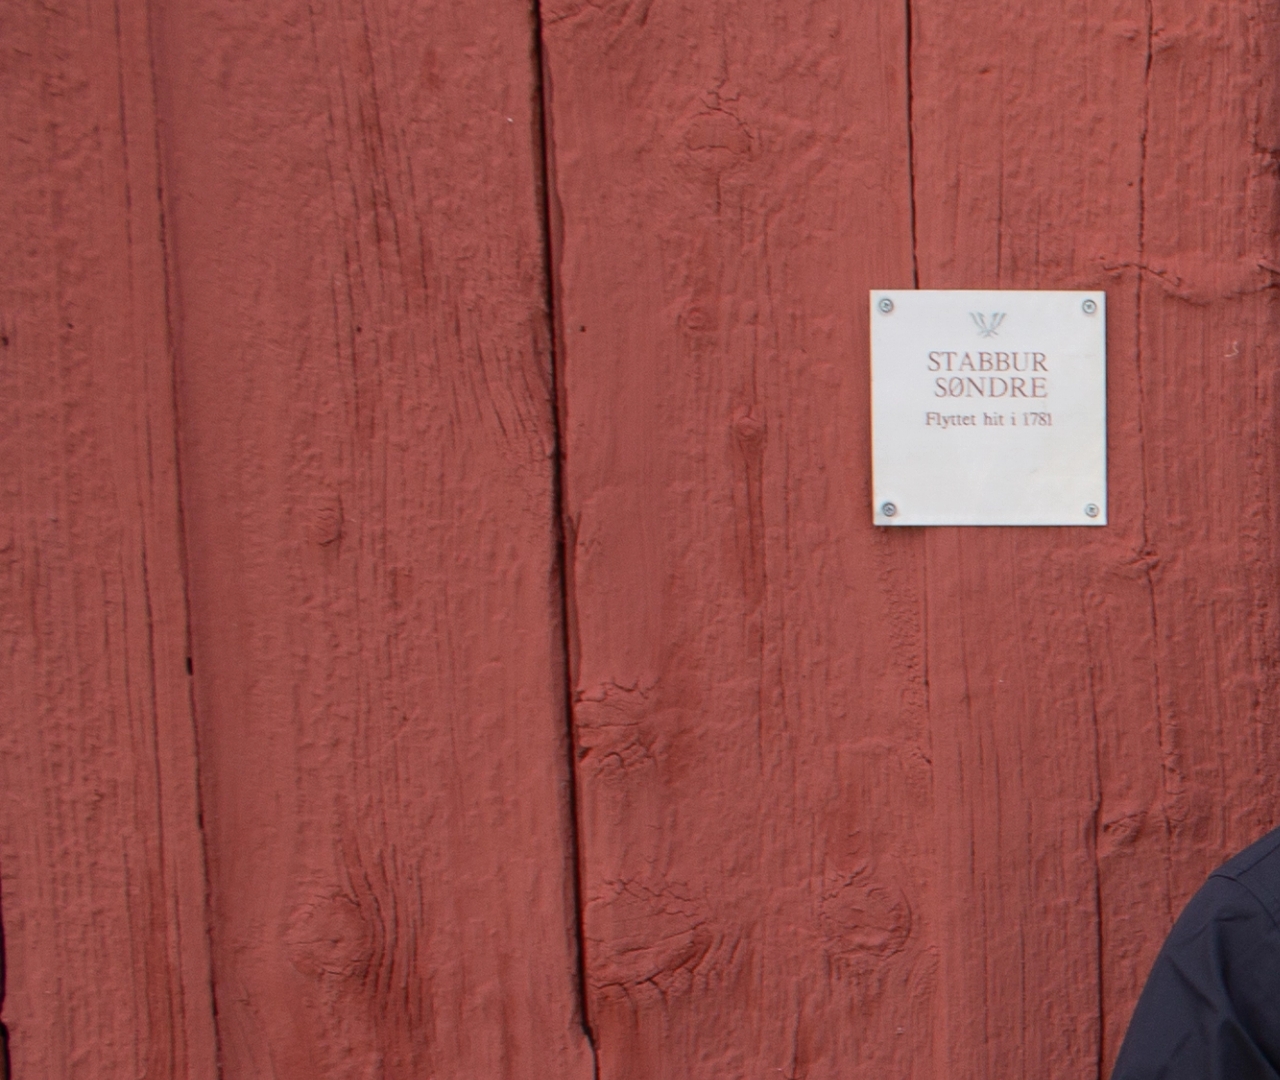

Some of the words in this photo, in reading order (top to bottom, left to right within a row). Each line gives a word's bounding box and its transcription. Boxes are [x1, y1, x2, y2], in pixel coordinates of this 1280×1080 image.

[927, 351, 1049, 372] STABBUR
[934, 376, 1049, 398] SØNDRE
[925, 412, 976, 429] Flyttet
[983, 412, 1005, 427] hit
[1011, 412, 1017, 427] i
[1023, 412, 1053, 427] 1781
